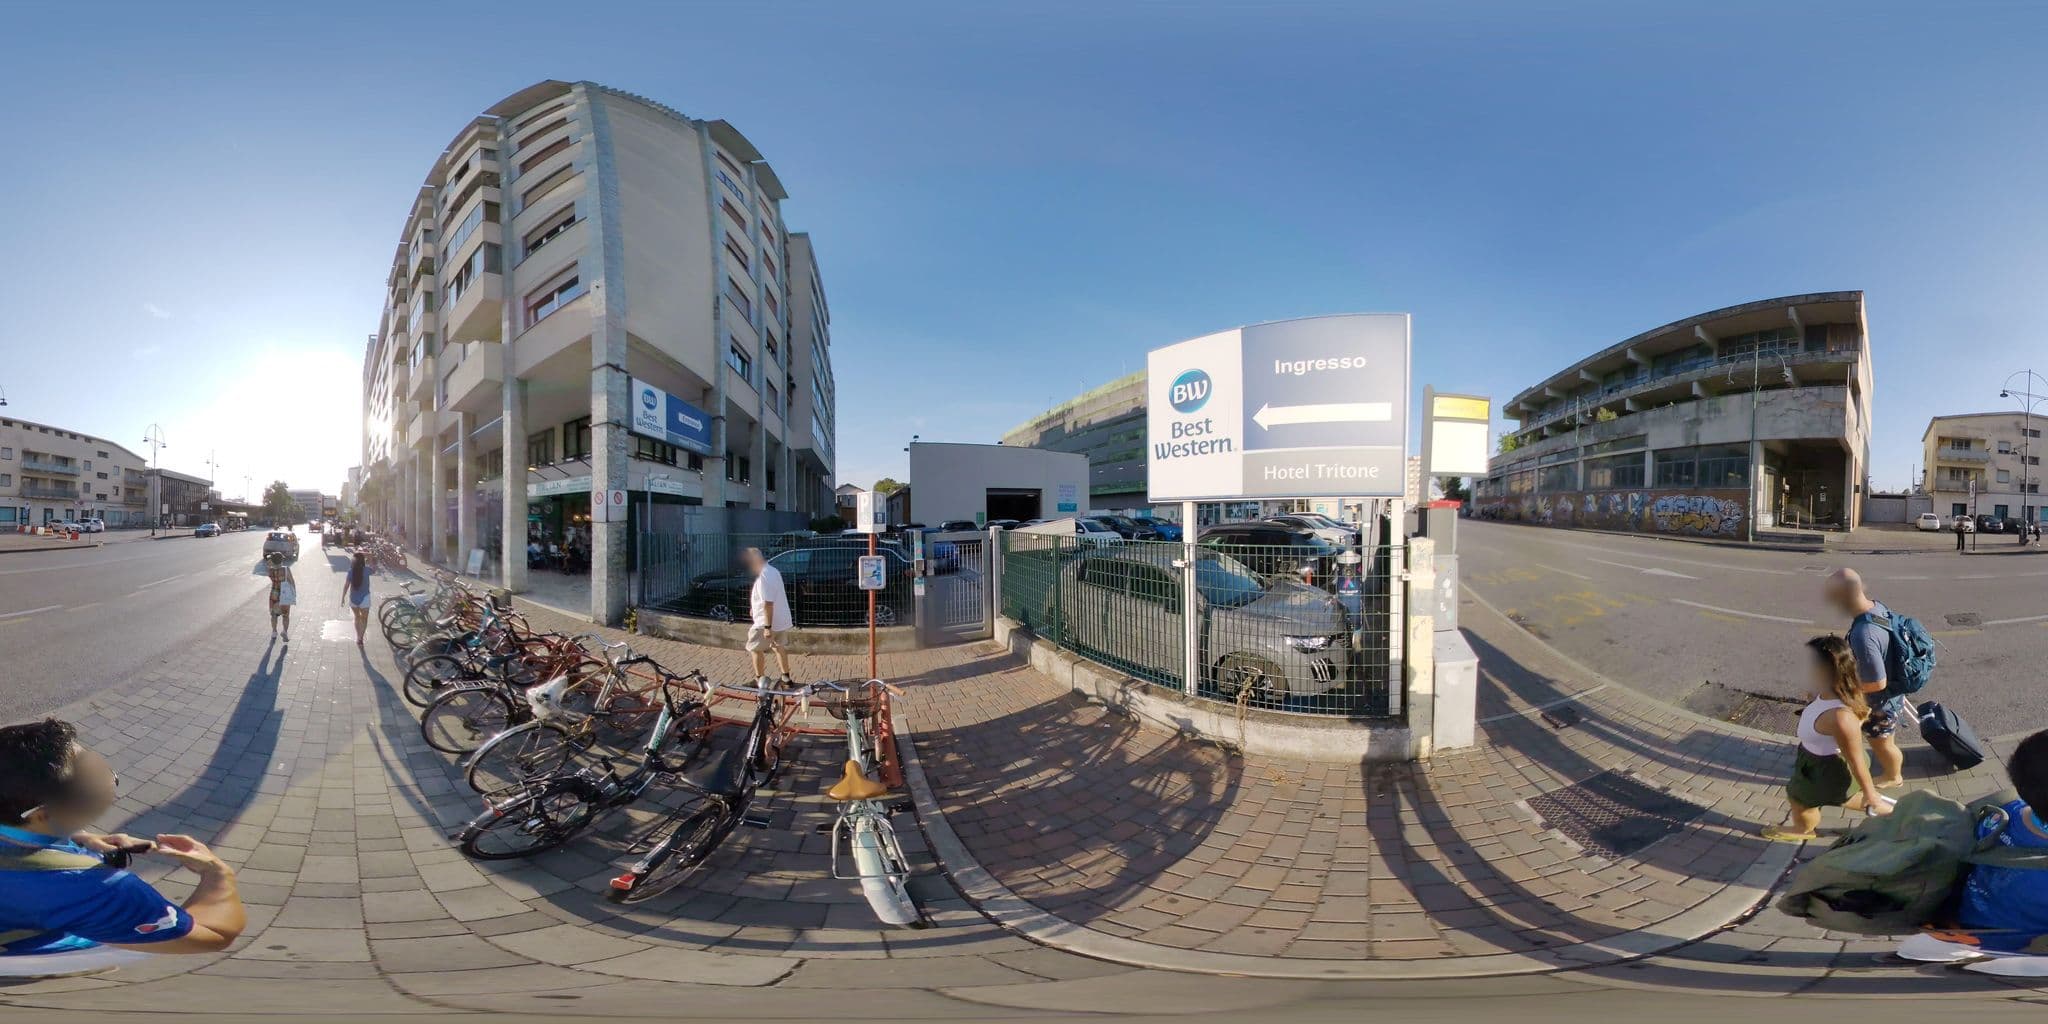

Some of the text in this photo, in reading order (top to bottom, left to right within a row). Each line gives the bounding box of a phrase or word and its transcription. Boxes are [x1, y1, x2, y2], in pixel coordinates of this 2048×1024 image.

[1275, 356, 1366, 376] Ingresso
[1173, 380, 1208, 405] BW
[636, 416, 664, 433] Western
[643, 410, 658, 423] Best
[1171, 418, 1214, 439] Best
[1155, 438, 1232, 460] Western
[1264, 463, 1379, 480] Hotel Tritone
